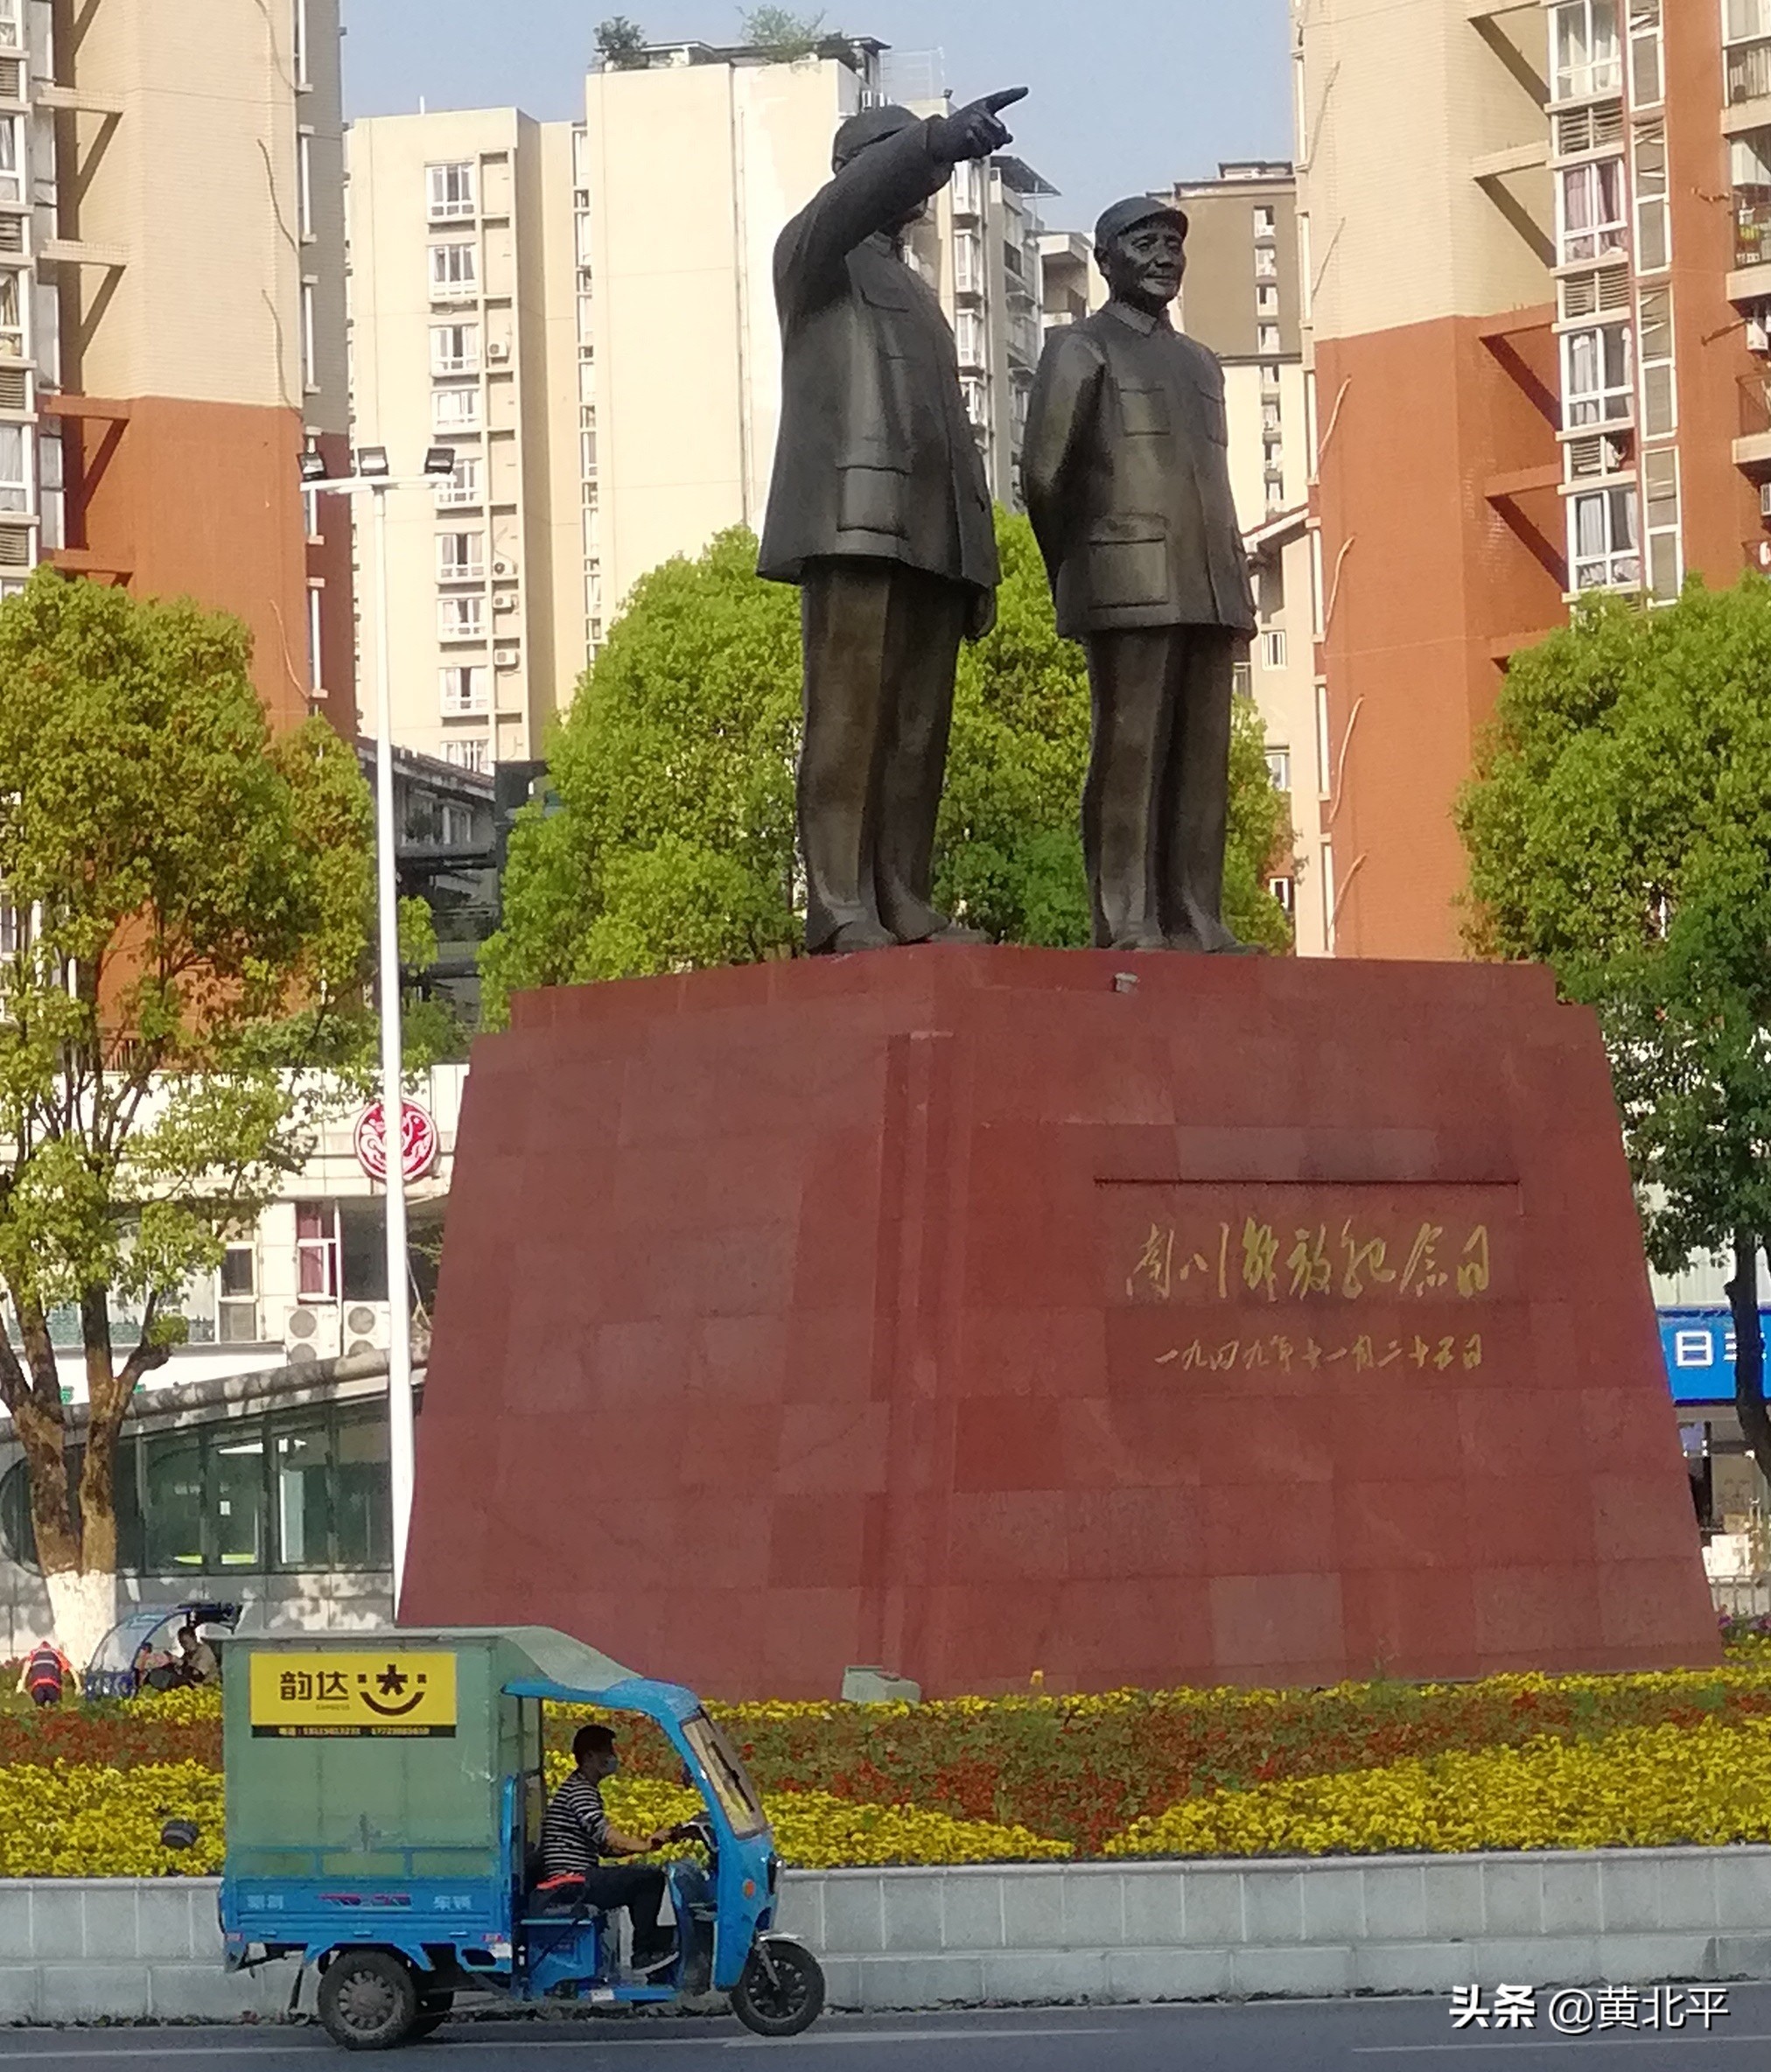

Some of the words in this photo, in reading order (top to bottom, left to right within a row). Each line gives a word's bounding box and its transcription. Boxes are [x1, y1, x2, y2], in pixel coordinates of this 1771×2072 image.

[1155, 1334, 1482, 1373] 一九四九年十一月二十五日
[280, 1670, 349, 1701] 韵达
